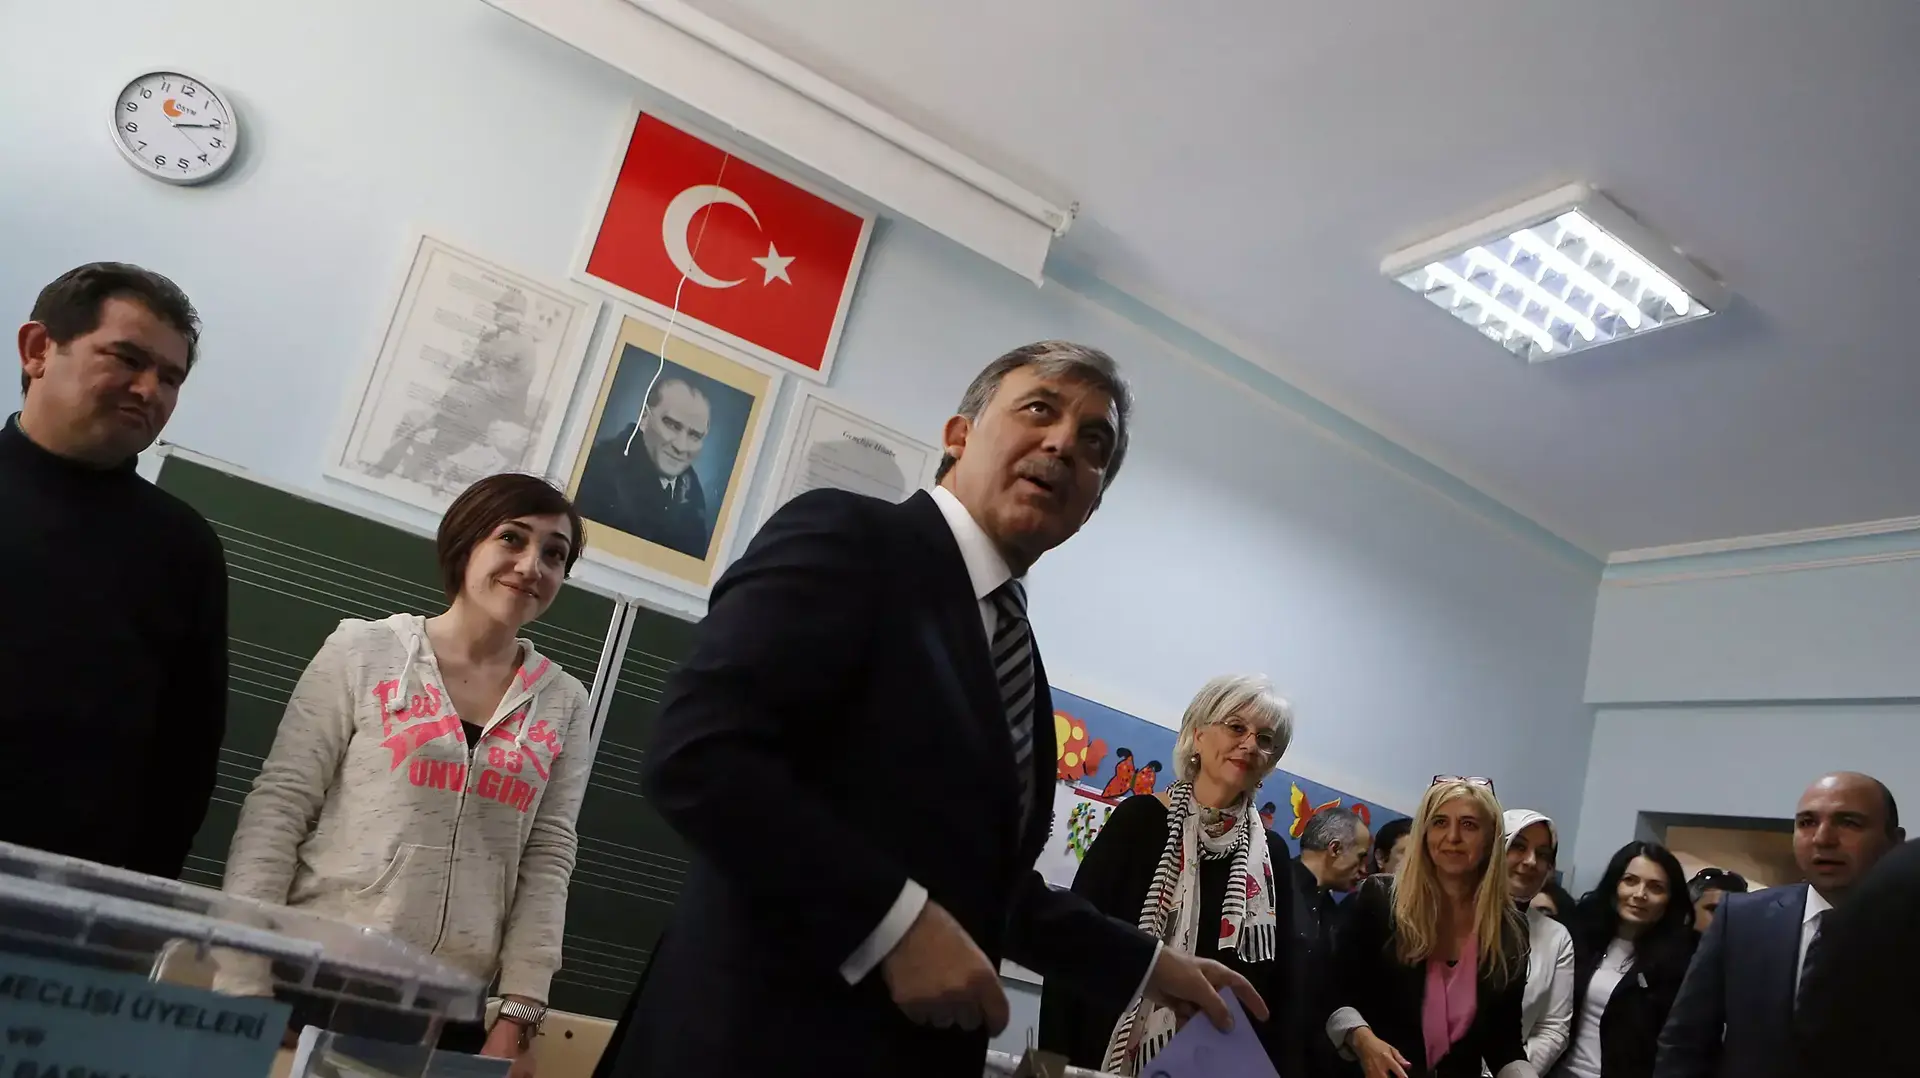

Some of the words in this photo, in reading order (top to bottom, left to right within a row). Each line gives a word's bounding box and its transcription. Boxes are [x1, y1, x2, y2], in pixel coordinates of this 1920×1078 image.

[140, 87, 152, 99] 10
[161, 82, 171, 93] 11
[181, 84, 196, 98] 12
[126, 102, 138, 112] 9
[204, 100, 210, 110] 1
[125, 122, 138, 133] 8
[209, 118, 221, 130] 2
[138, 140, 148, 151] 7
[210, 137, 222, 148] 3
[155, 155, 166, 166] 6
[177, 158, 190, 169] 5
[197, 153, 208, 163] 4
[488, 746, 523, 775] 83
